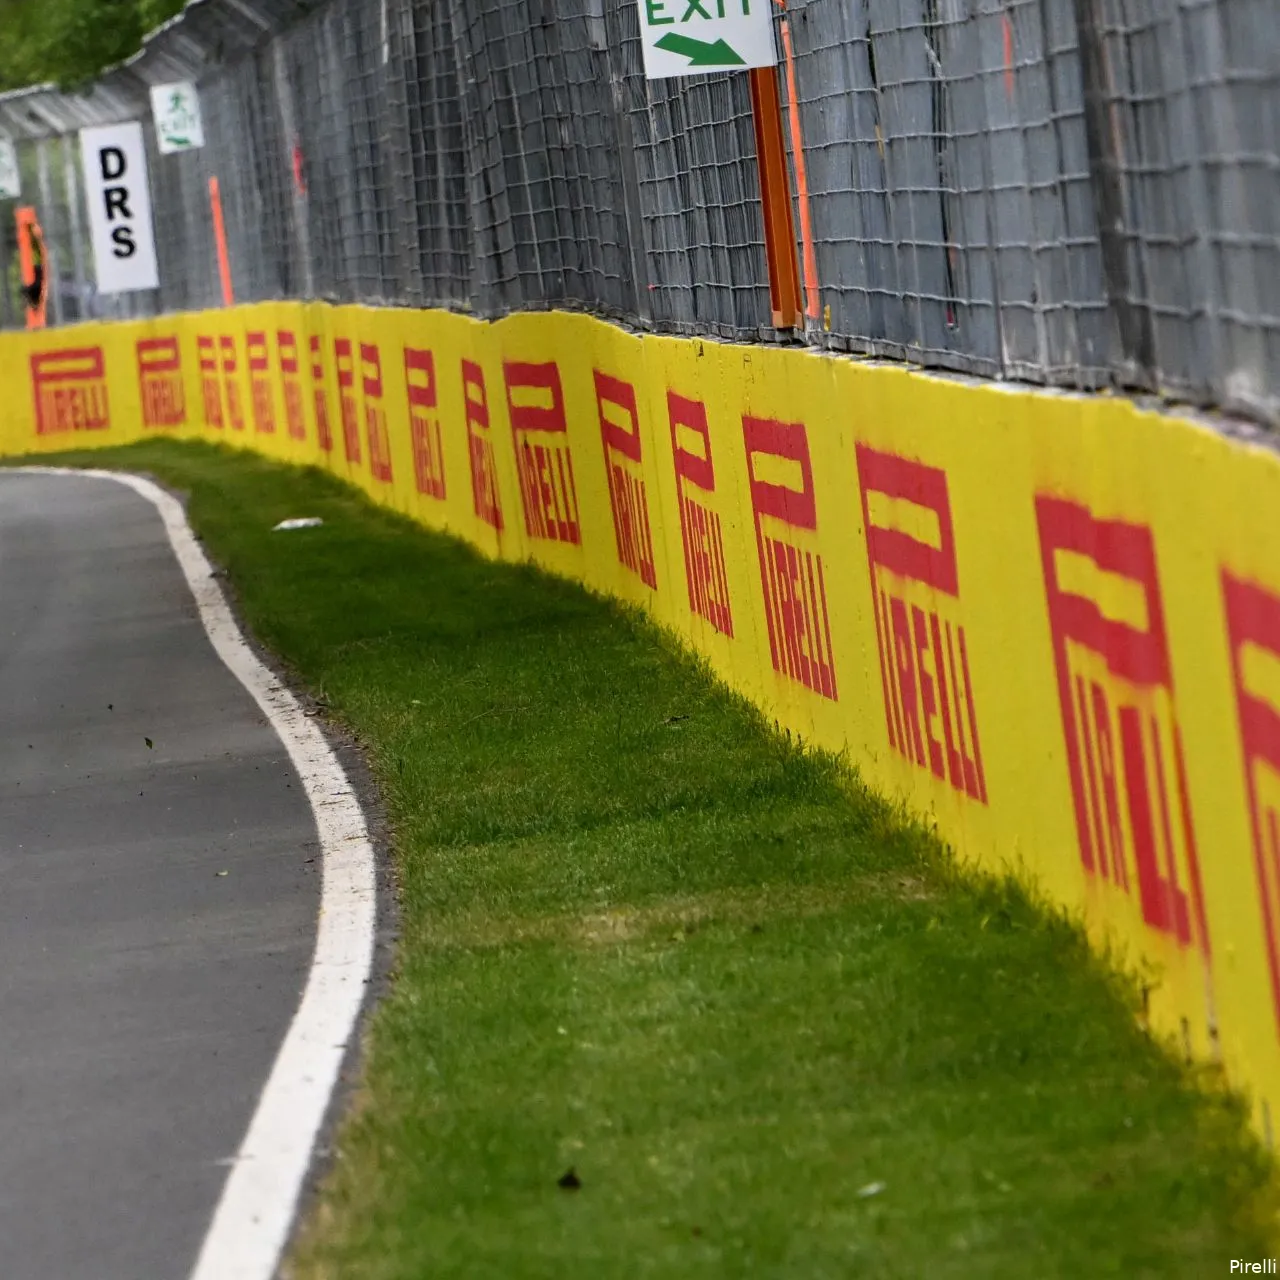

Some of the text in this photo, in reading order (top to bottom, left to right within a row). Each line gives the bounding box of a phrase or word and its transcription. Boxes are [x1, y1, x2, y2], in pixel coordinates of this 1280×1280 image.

[99, 147, 135, 258] DRS
[502, 360, 581, 545] PIRELLI
[592, 368, 658, 591] PIRELLI
[666, 389, 734, 639] PIRELLI
[741, 414, 838, 701] PIRELLI
[855, 441, 988, 805] PIRELLI
